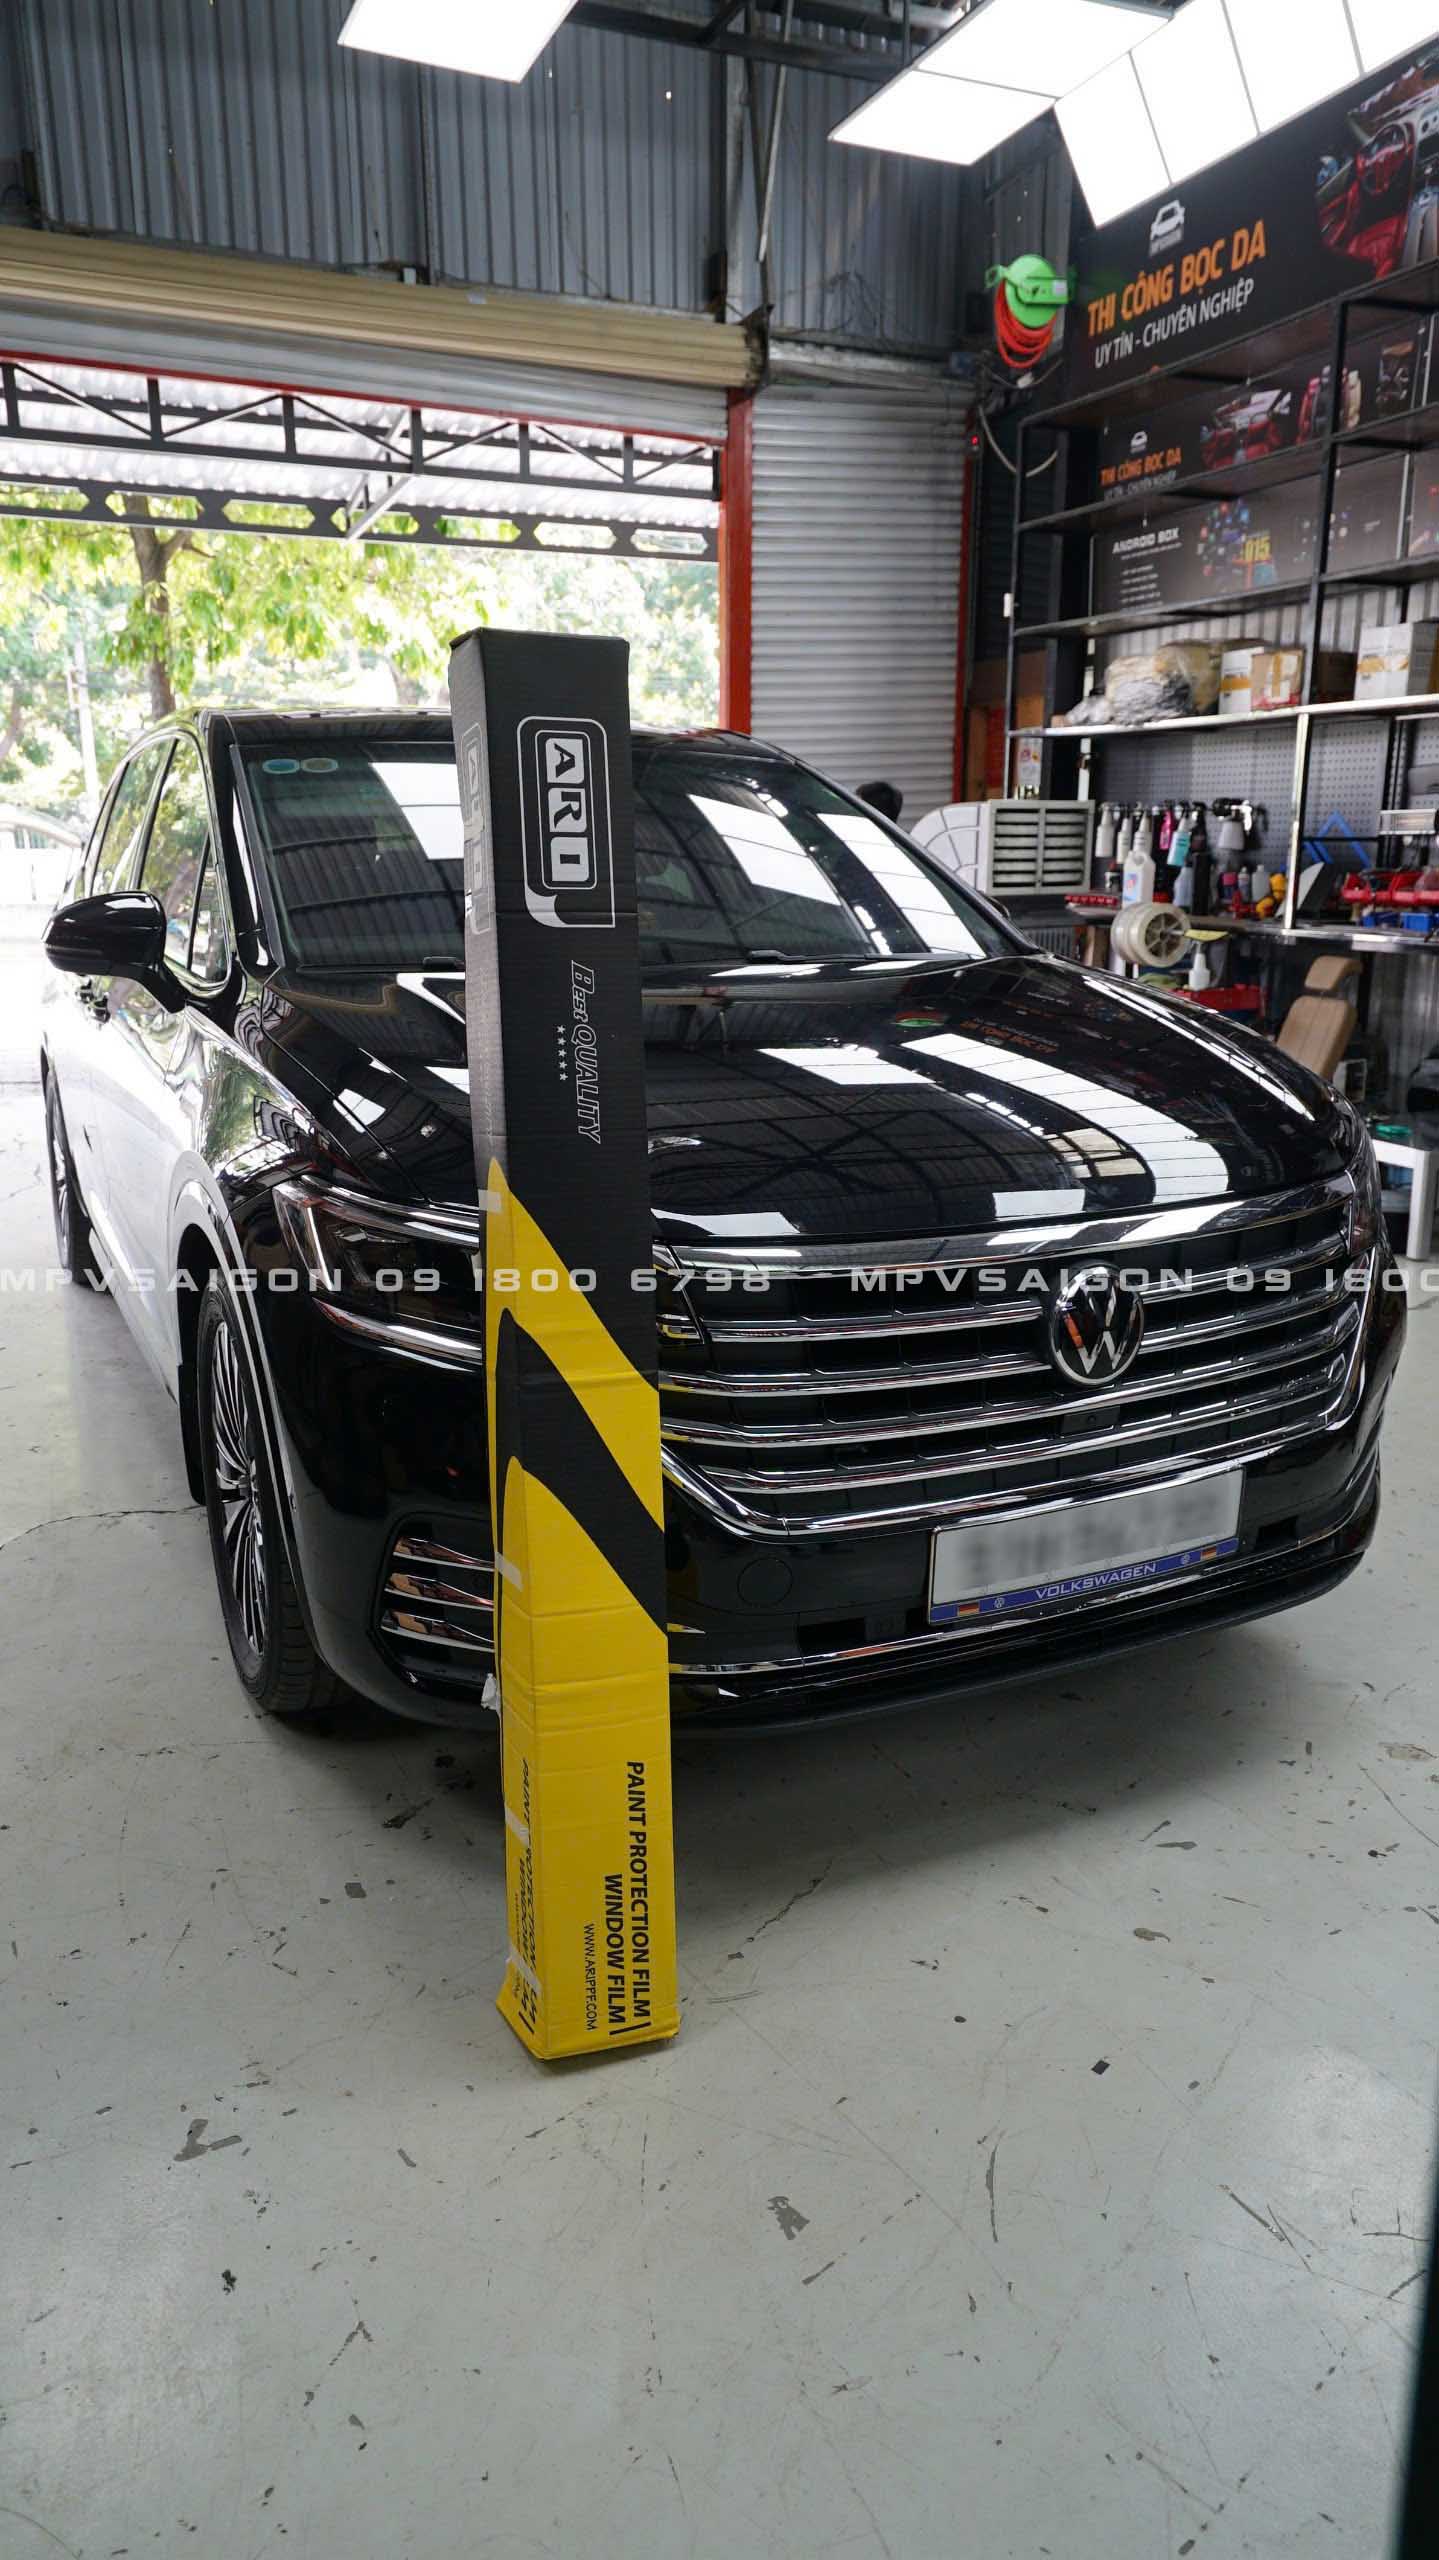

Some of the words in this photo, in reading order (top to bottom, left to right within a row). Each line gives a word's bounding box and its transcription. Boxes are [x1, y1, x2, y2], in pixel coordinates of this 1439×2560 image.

[1088, 292, 1117, 336] THI
[1121, 264, 1174, 321] CÔNG
[1179, 238, 1226, 295] BỌC
[1231, 219, 1266, 271] DA
[1095, 342, 1113, 368] UY
[1143, 303, 1197, 347] CHUYÊN
[1199, 277, 1254, 324] NGHIỆP
[1111, 533, 1156, 555] ANDROID
[1157, 527, 1180, 544] BOX
[571, 959, 595, 1025] Best
[571, 1023, 601, 1145] QUALITY
[1035, 1562, 1157, 1600] VOLKSWAGEN
[627, 1761, 647, 1827] PAINT
[604, 1873, 625, 1970] WINDOW
[629, 1830, 650, 1963] PROTECTION
[583, 1923, 598, 2031] WWW.ARIPPF.COM
[607, 1974, 626, 2024] FILM
[632, 1968, 651, 2018] FILM
